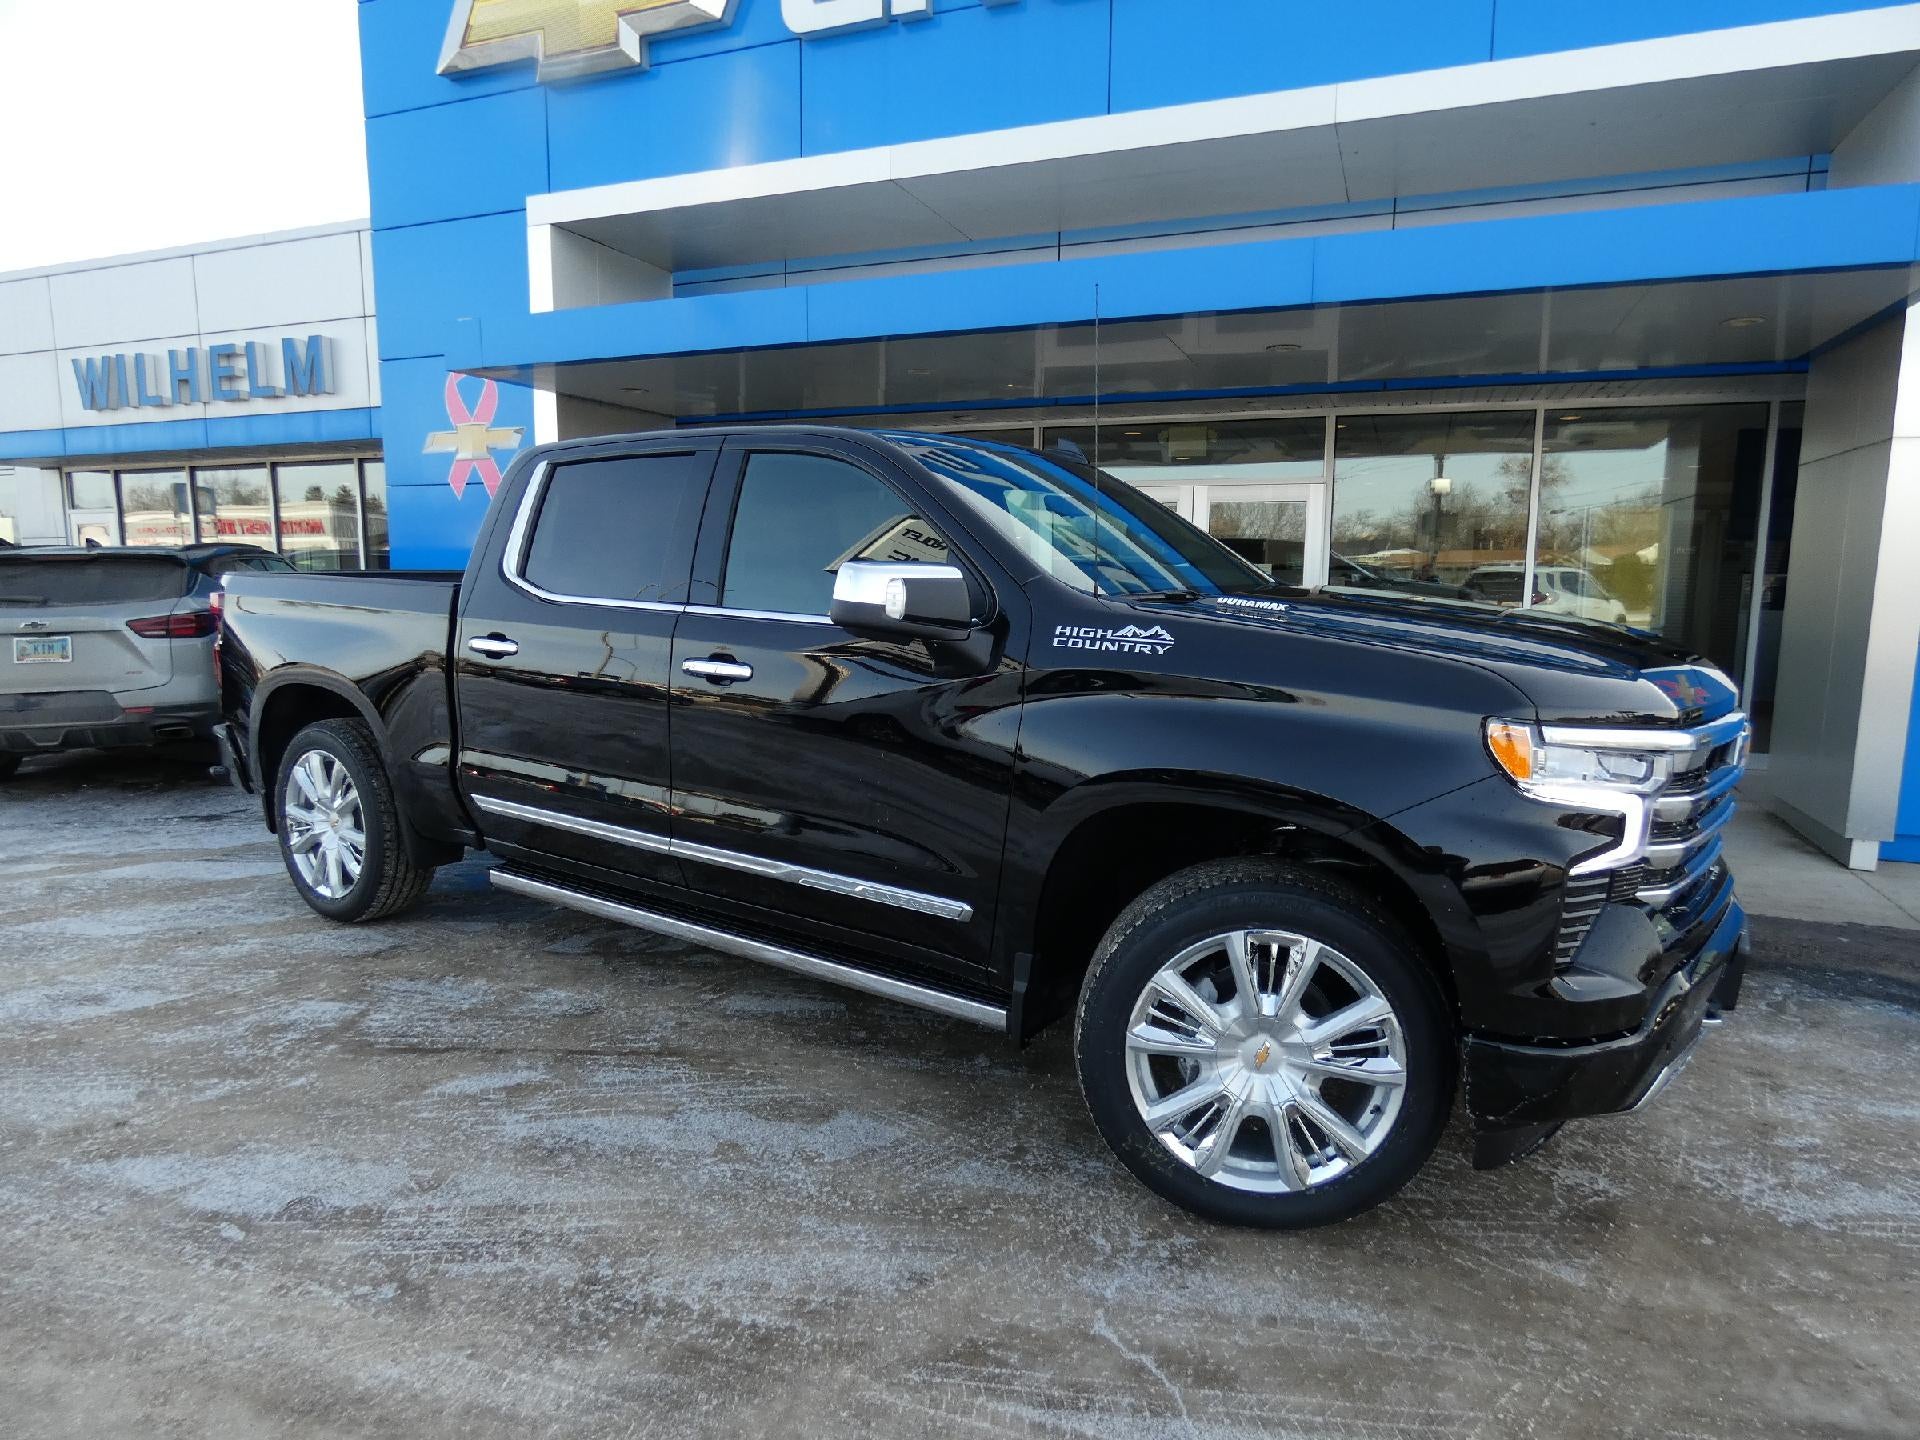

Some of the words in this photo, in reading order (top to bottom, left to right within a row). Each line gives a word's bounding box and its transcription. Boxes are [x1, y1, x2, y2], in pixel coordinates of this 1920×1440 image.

[72, 335, 331, 410] WILHELM
[1216, 597, 1289, 611] DURAMAX
[1055, 625, 1113, 638] HIGH
[1052, 637, 1174, 655] COUNTRY
